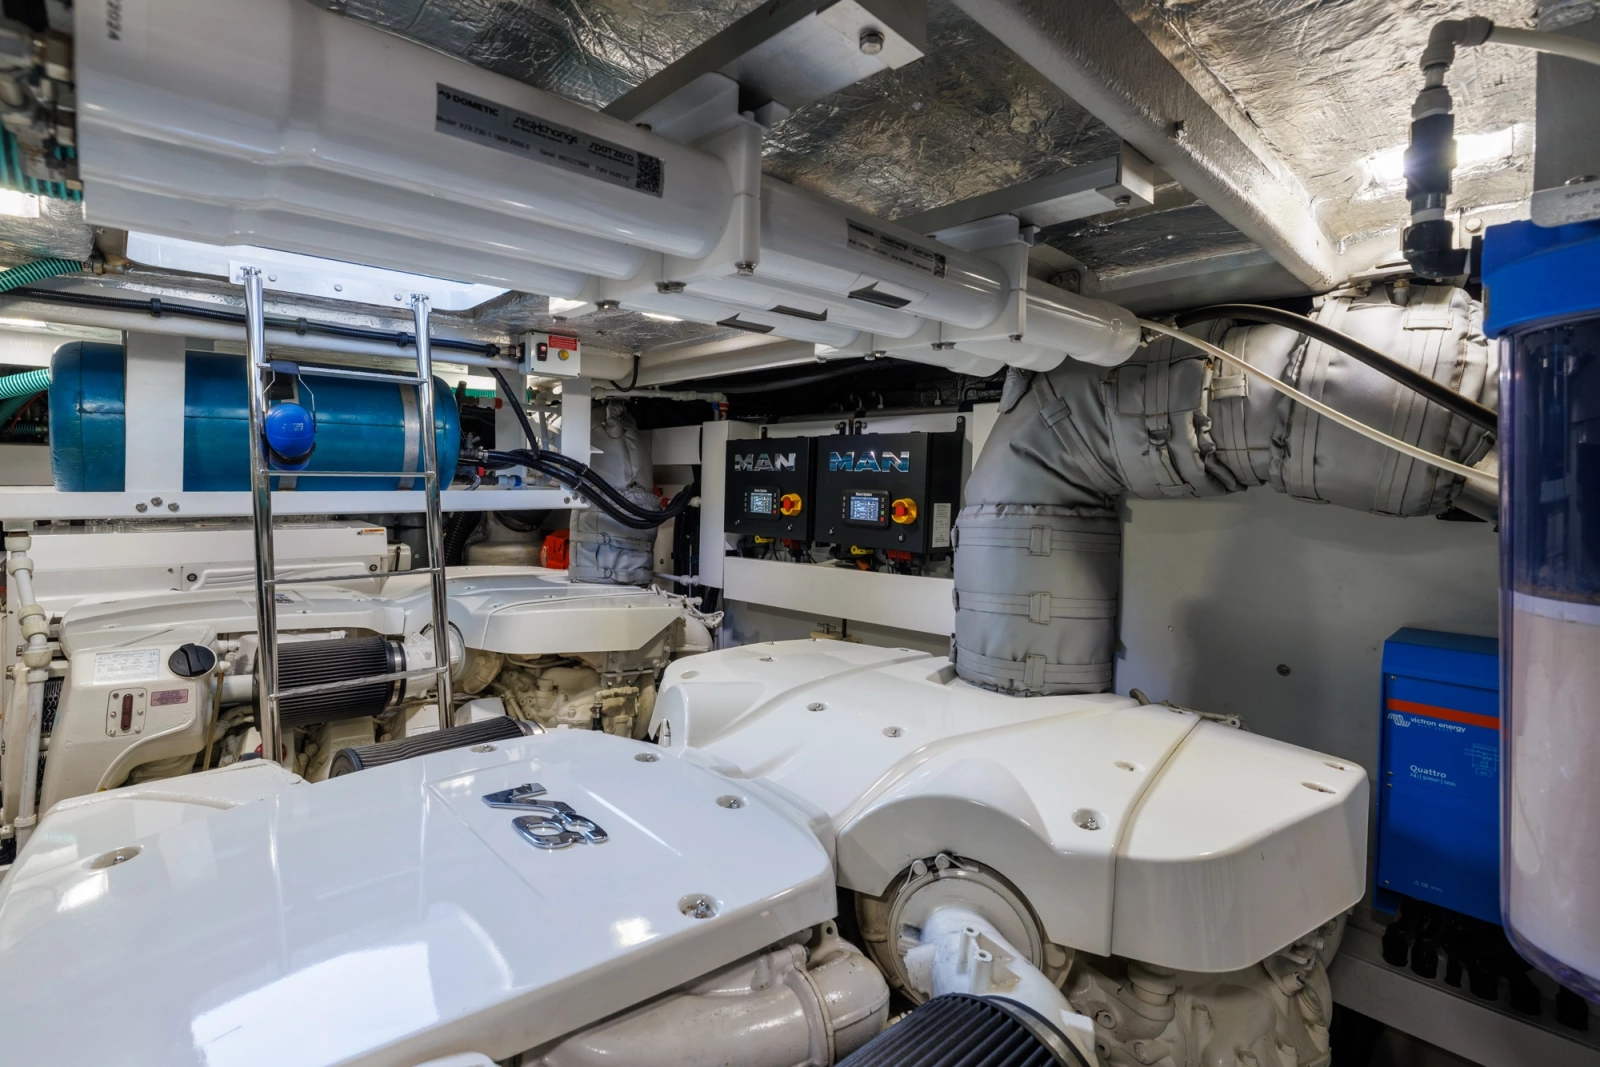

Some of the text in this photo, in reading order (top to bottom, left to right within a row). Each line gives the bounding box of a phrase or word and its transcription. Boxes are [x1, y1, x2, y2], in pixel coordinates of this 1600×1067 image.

[452, 95, 499, 117] DOMETIC
[734, 452, 797, 472] MAN
[829, 450, 910, 473] MAN
[1410, 717, 1436, 727] victron
[1438, 722, 1466, 734] energy
[1410, 764, 1447, 779] Quattro
